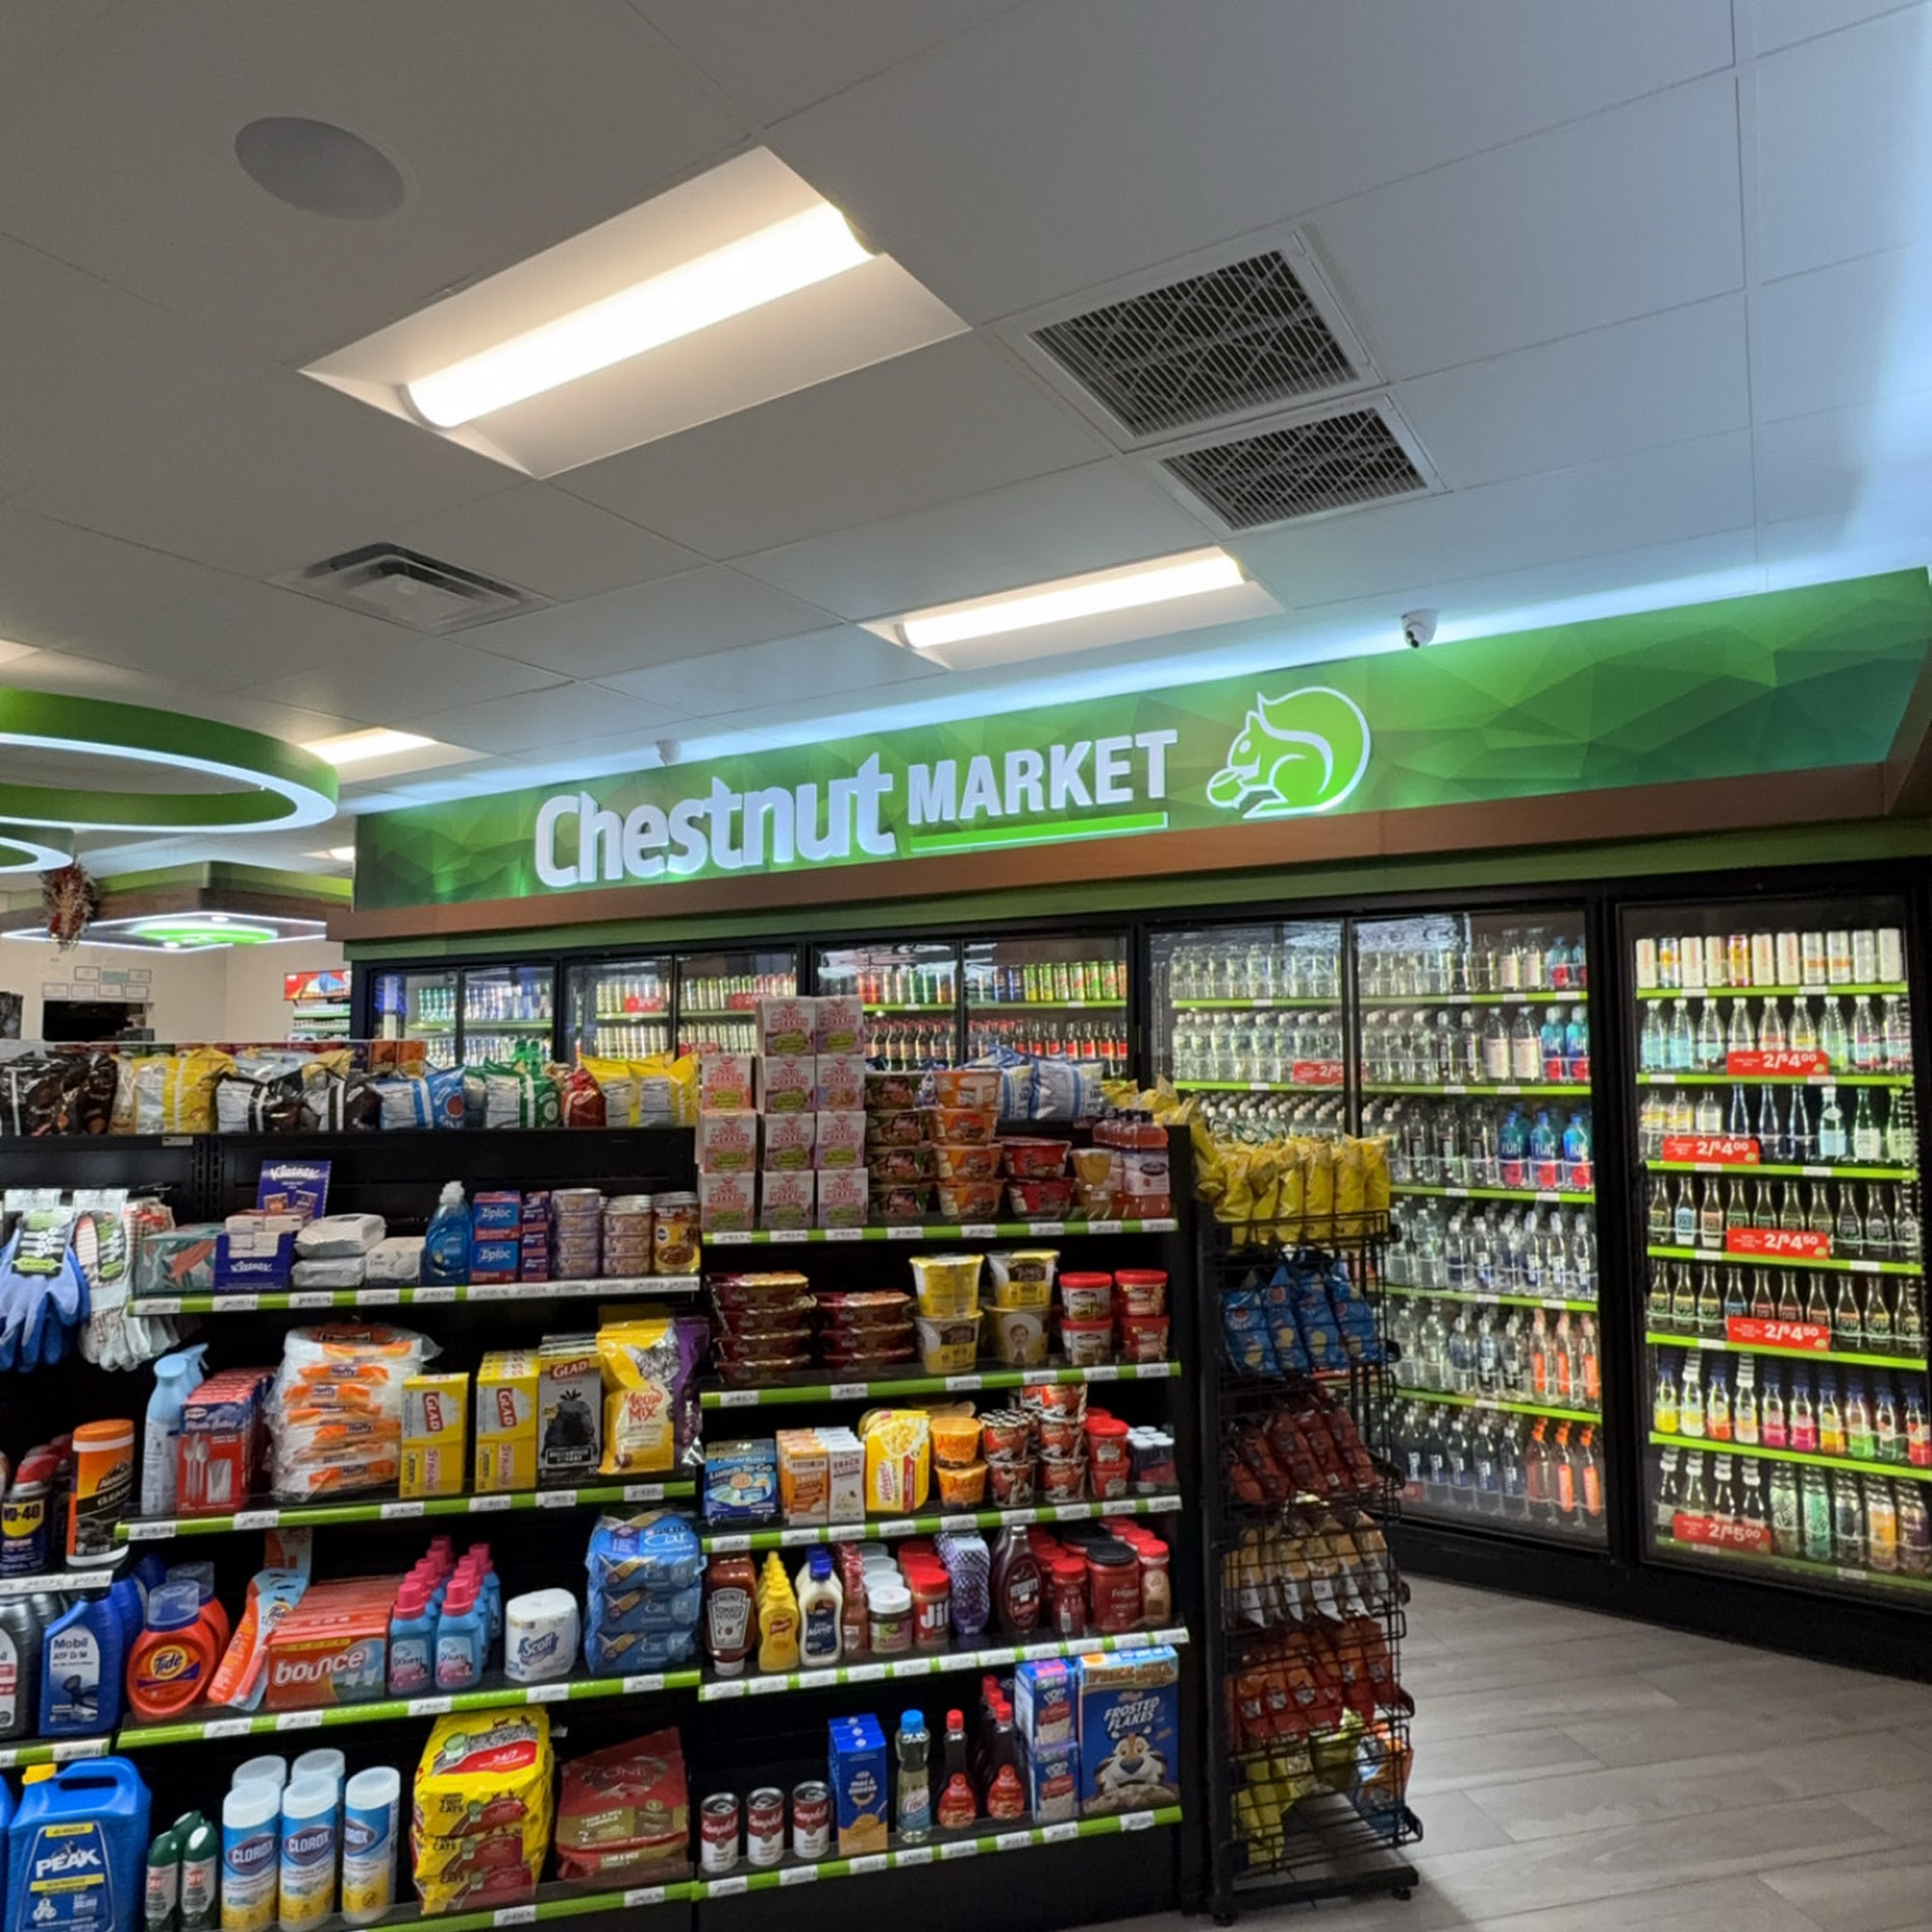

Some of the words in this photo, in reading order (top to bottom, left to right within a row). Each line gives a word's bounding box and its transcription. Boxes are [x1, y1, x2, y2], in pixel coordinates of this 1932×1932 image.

[534, 753, 896, 888] Chestnut
[908, 729, 1178, 826] MARKET
[553, 1360, 589, 1378] GLAD
[425, 1393, 443, 1432] GLAD
[497, 1389, 516, 1427] GLAD
[715, 1605, 745, 1614] TOMATO
[54, 1637, 88, 1650] Mobil
[522, 1636, 554, 1657] Scott
[154, 1654, 183, 1675] Tide
[274, 1648, 366, 1685] bounce
[1103, 1695, 1160, 1722] FROSTED
[1107, 1711, 1154, 1732] FLAKES
[233, 1839, 273, 1864] CLOROX
[288, 1829, 330, 1853] CLOROX
[37, 1849, 101, 1879] PEAK
